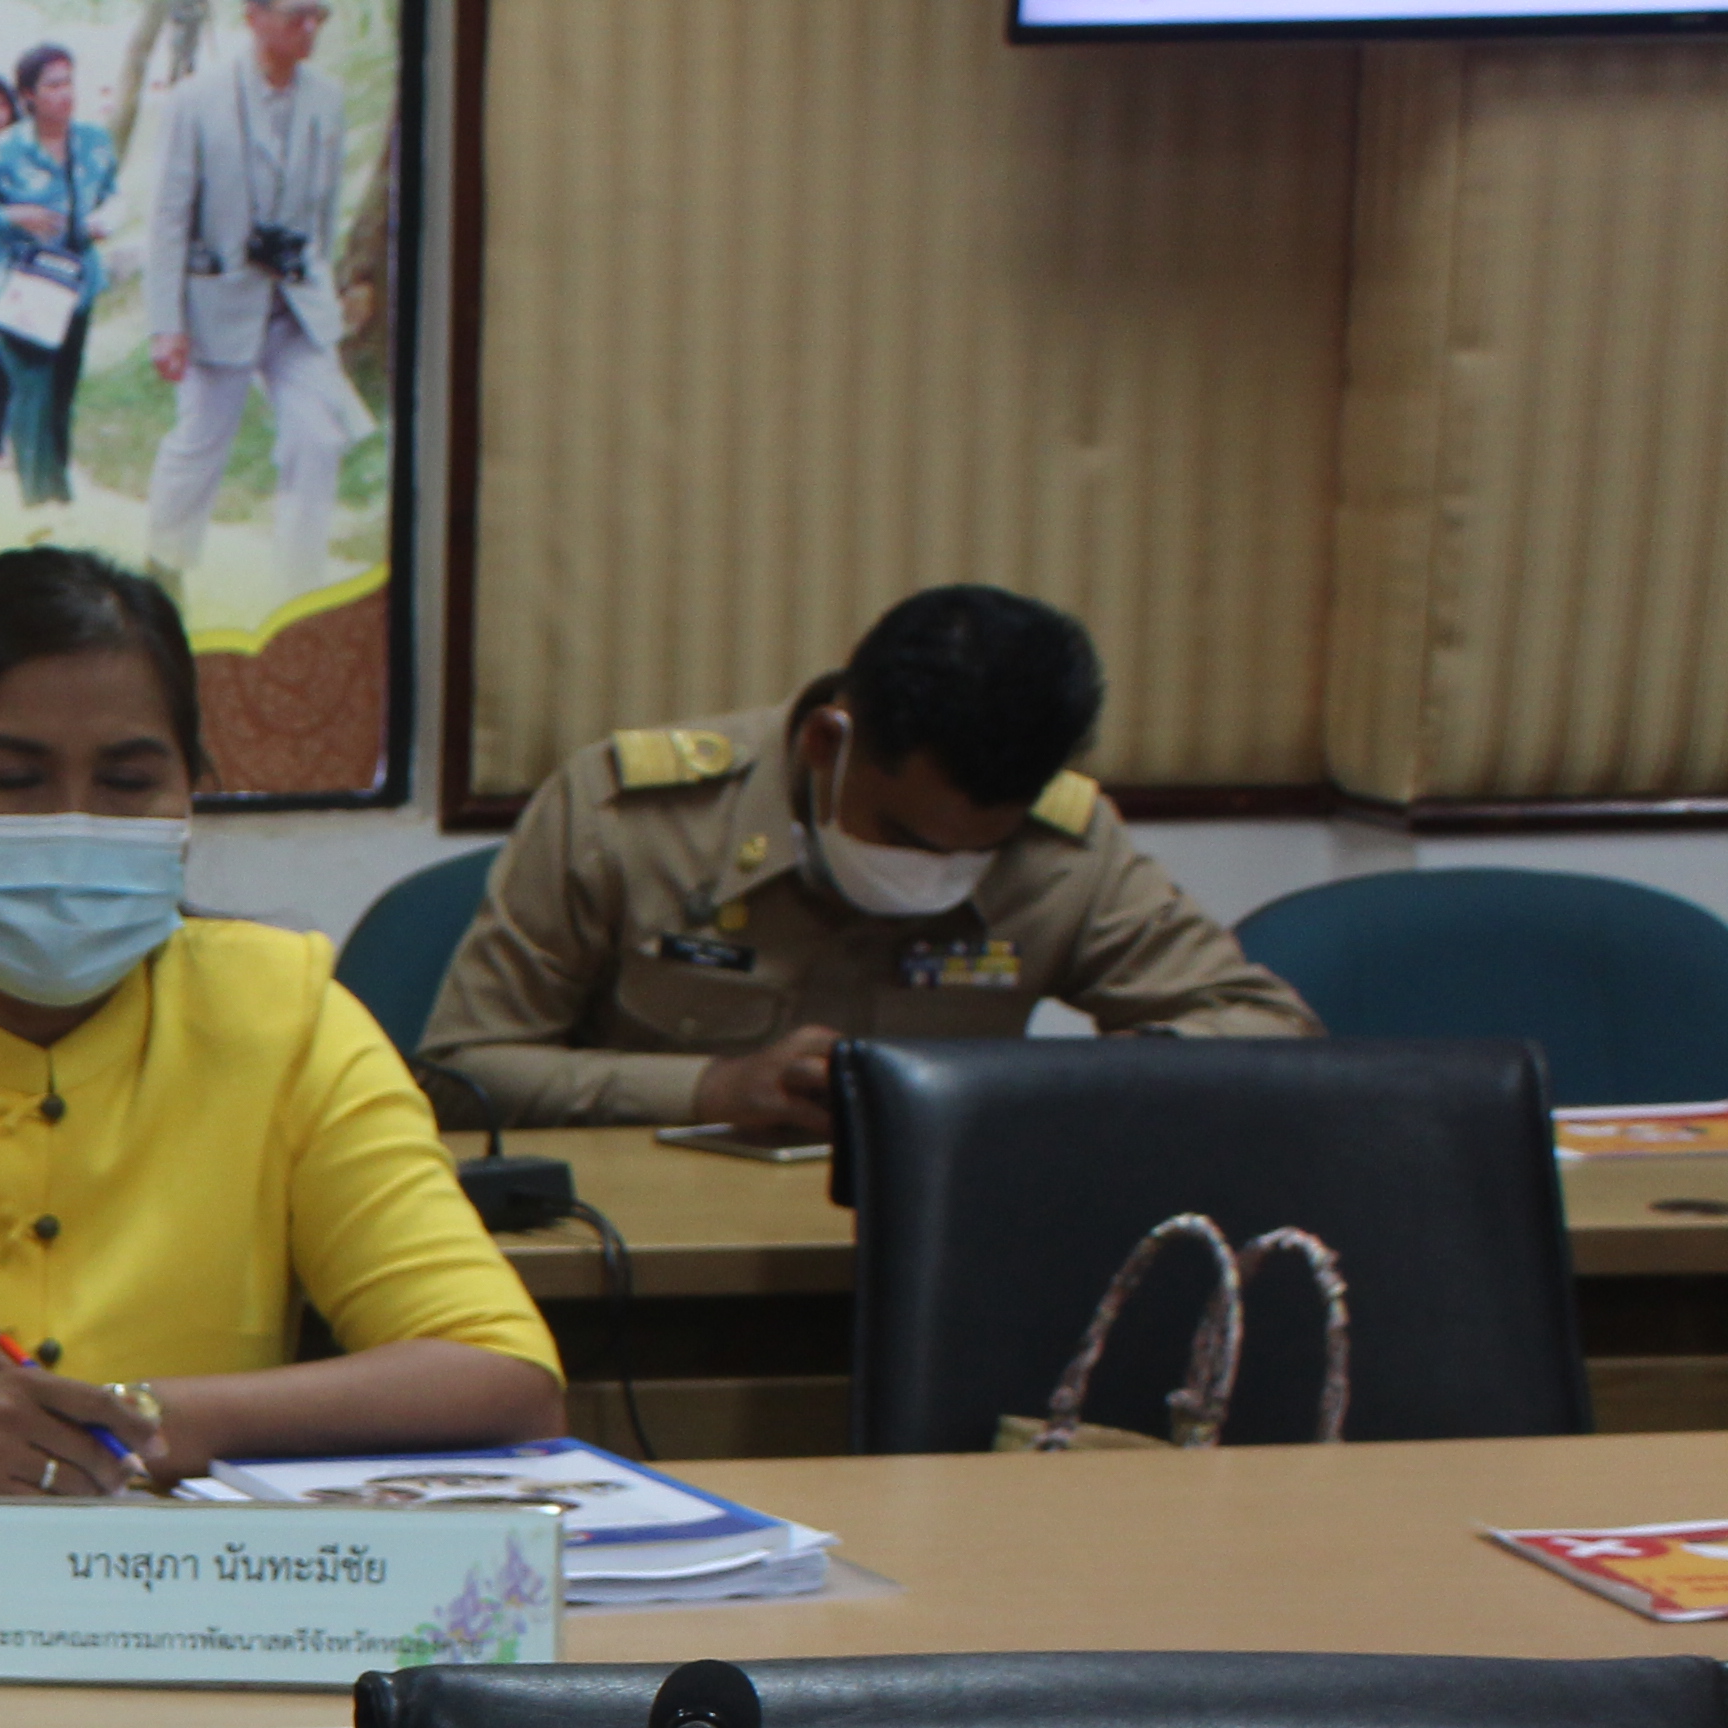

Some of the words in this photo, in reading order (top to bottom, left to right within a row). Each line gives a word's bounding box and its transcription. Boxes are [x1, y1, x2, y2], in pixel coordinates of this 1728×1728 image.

[68, 1547, 201, 1592] นางสุภา
[212, 1542, 388, 1585] นันทะมีชัย
